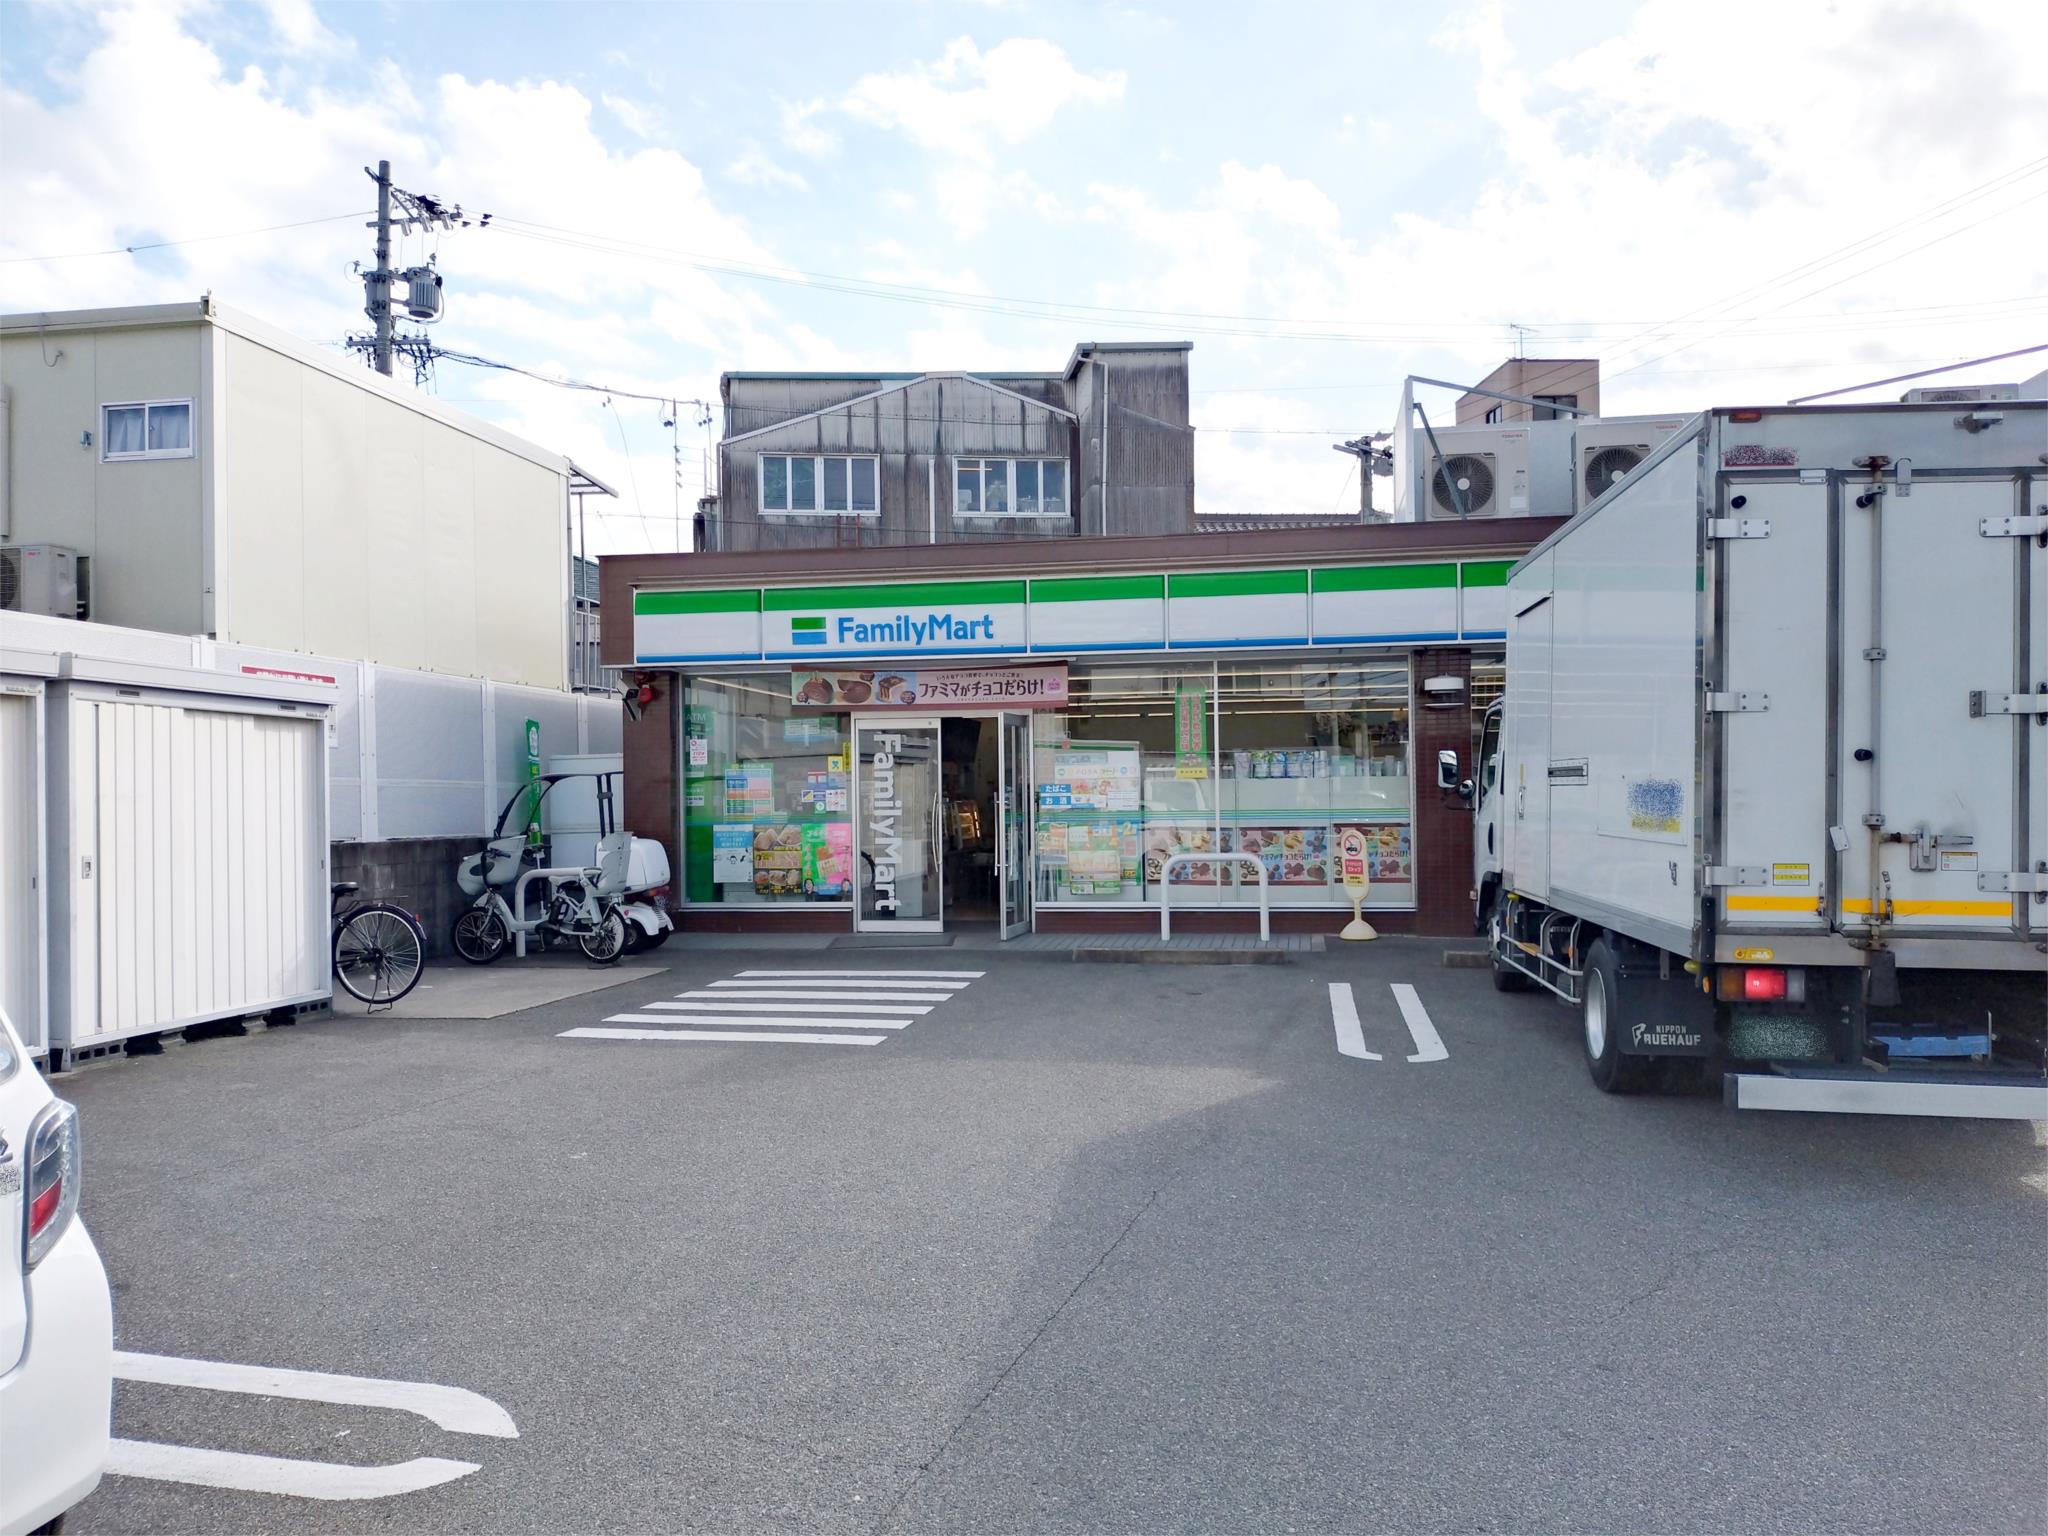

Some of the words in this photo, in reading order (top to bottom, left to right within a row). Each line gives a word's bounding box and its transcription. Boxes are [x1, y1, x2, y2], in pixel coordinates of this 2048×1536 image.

[838, 614, 994, 645] FamilyMart
[919, 678, 1044, 698] ファミマがチョコだらけ!
[1045, 784, 1067, 793] たばこ
[869, 733, 903, 911] FamilyMart
[1656, 1025, 1687, 1034] NIPPON
